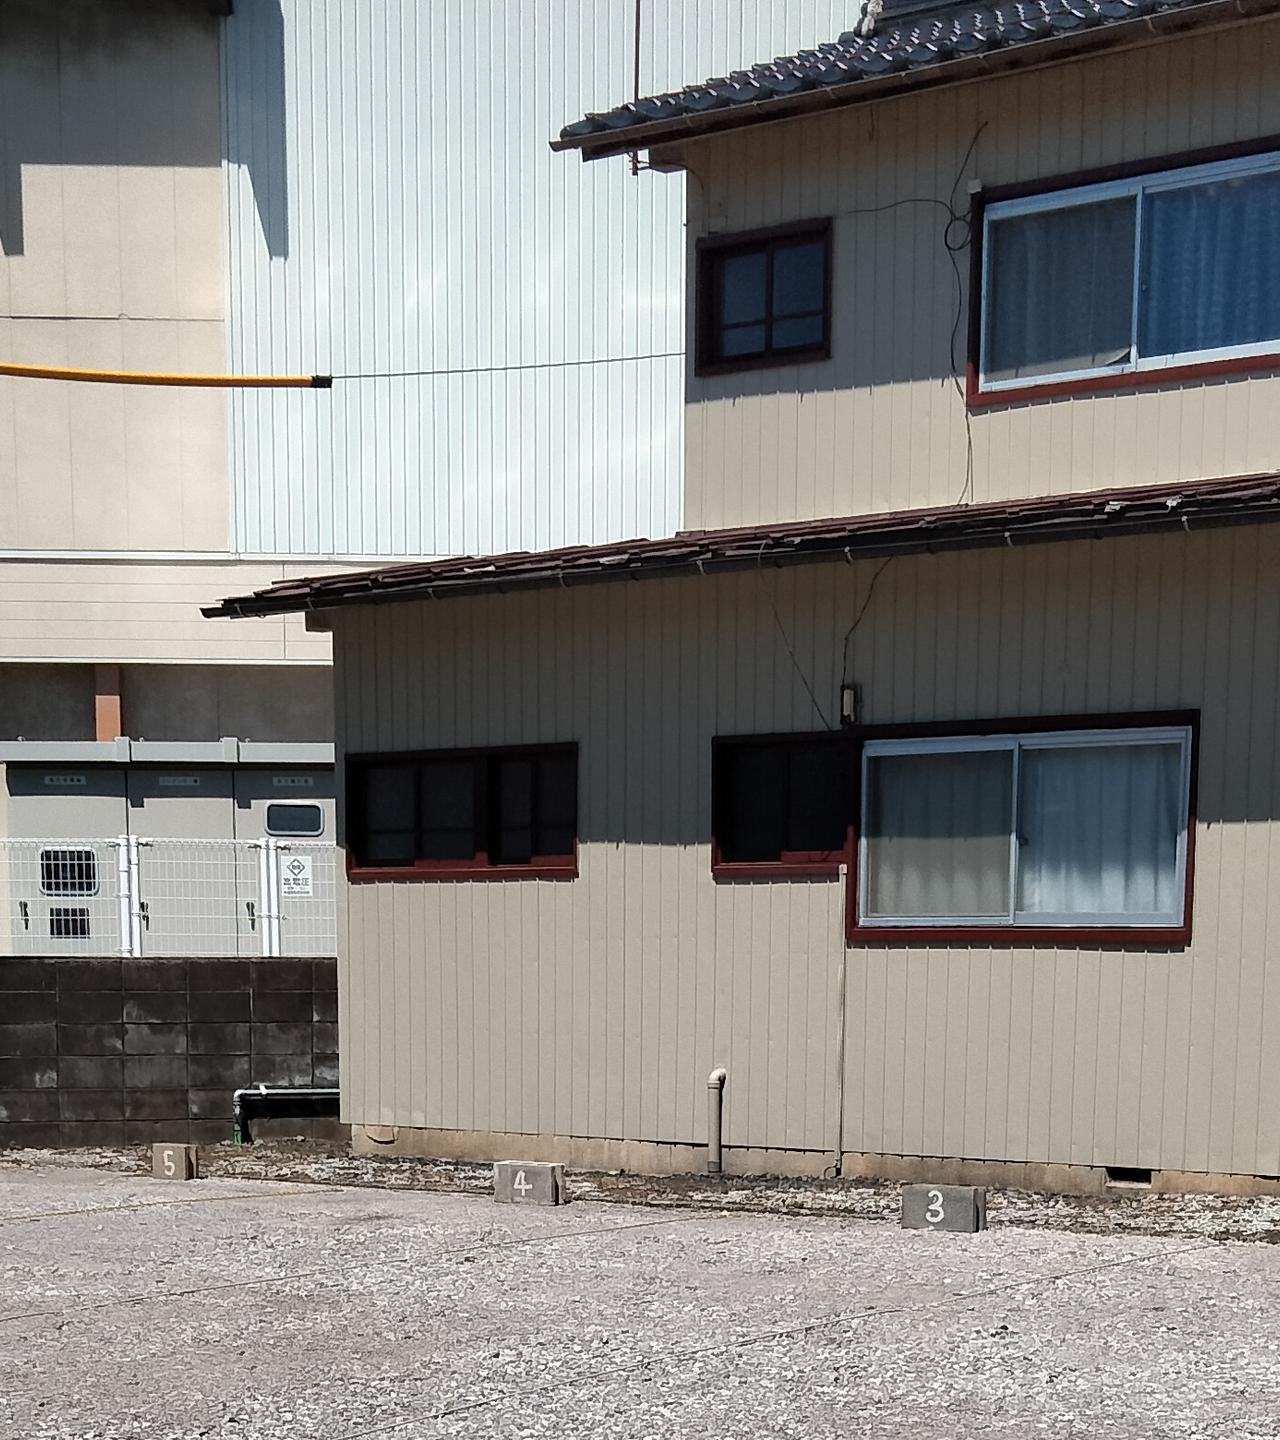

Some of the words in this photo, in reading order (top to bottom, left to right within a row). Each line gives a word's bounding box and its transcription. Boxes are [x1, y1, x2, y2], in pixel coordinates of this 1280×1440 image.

[163, 1150, 175, 1176] 5
[513, 1170, 533, 1196] 4
[925, 1190, 945, 1223] 3
